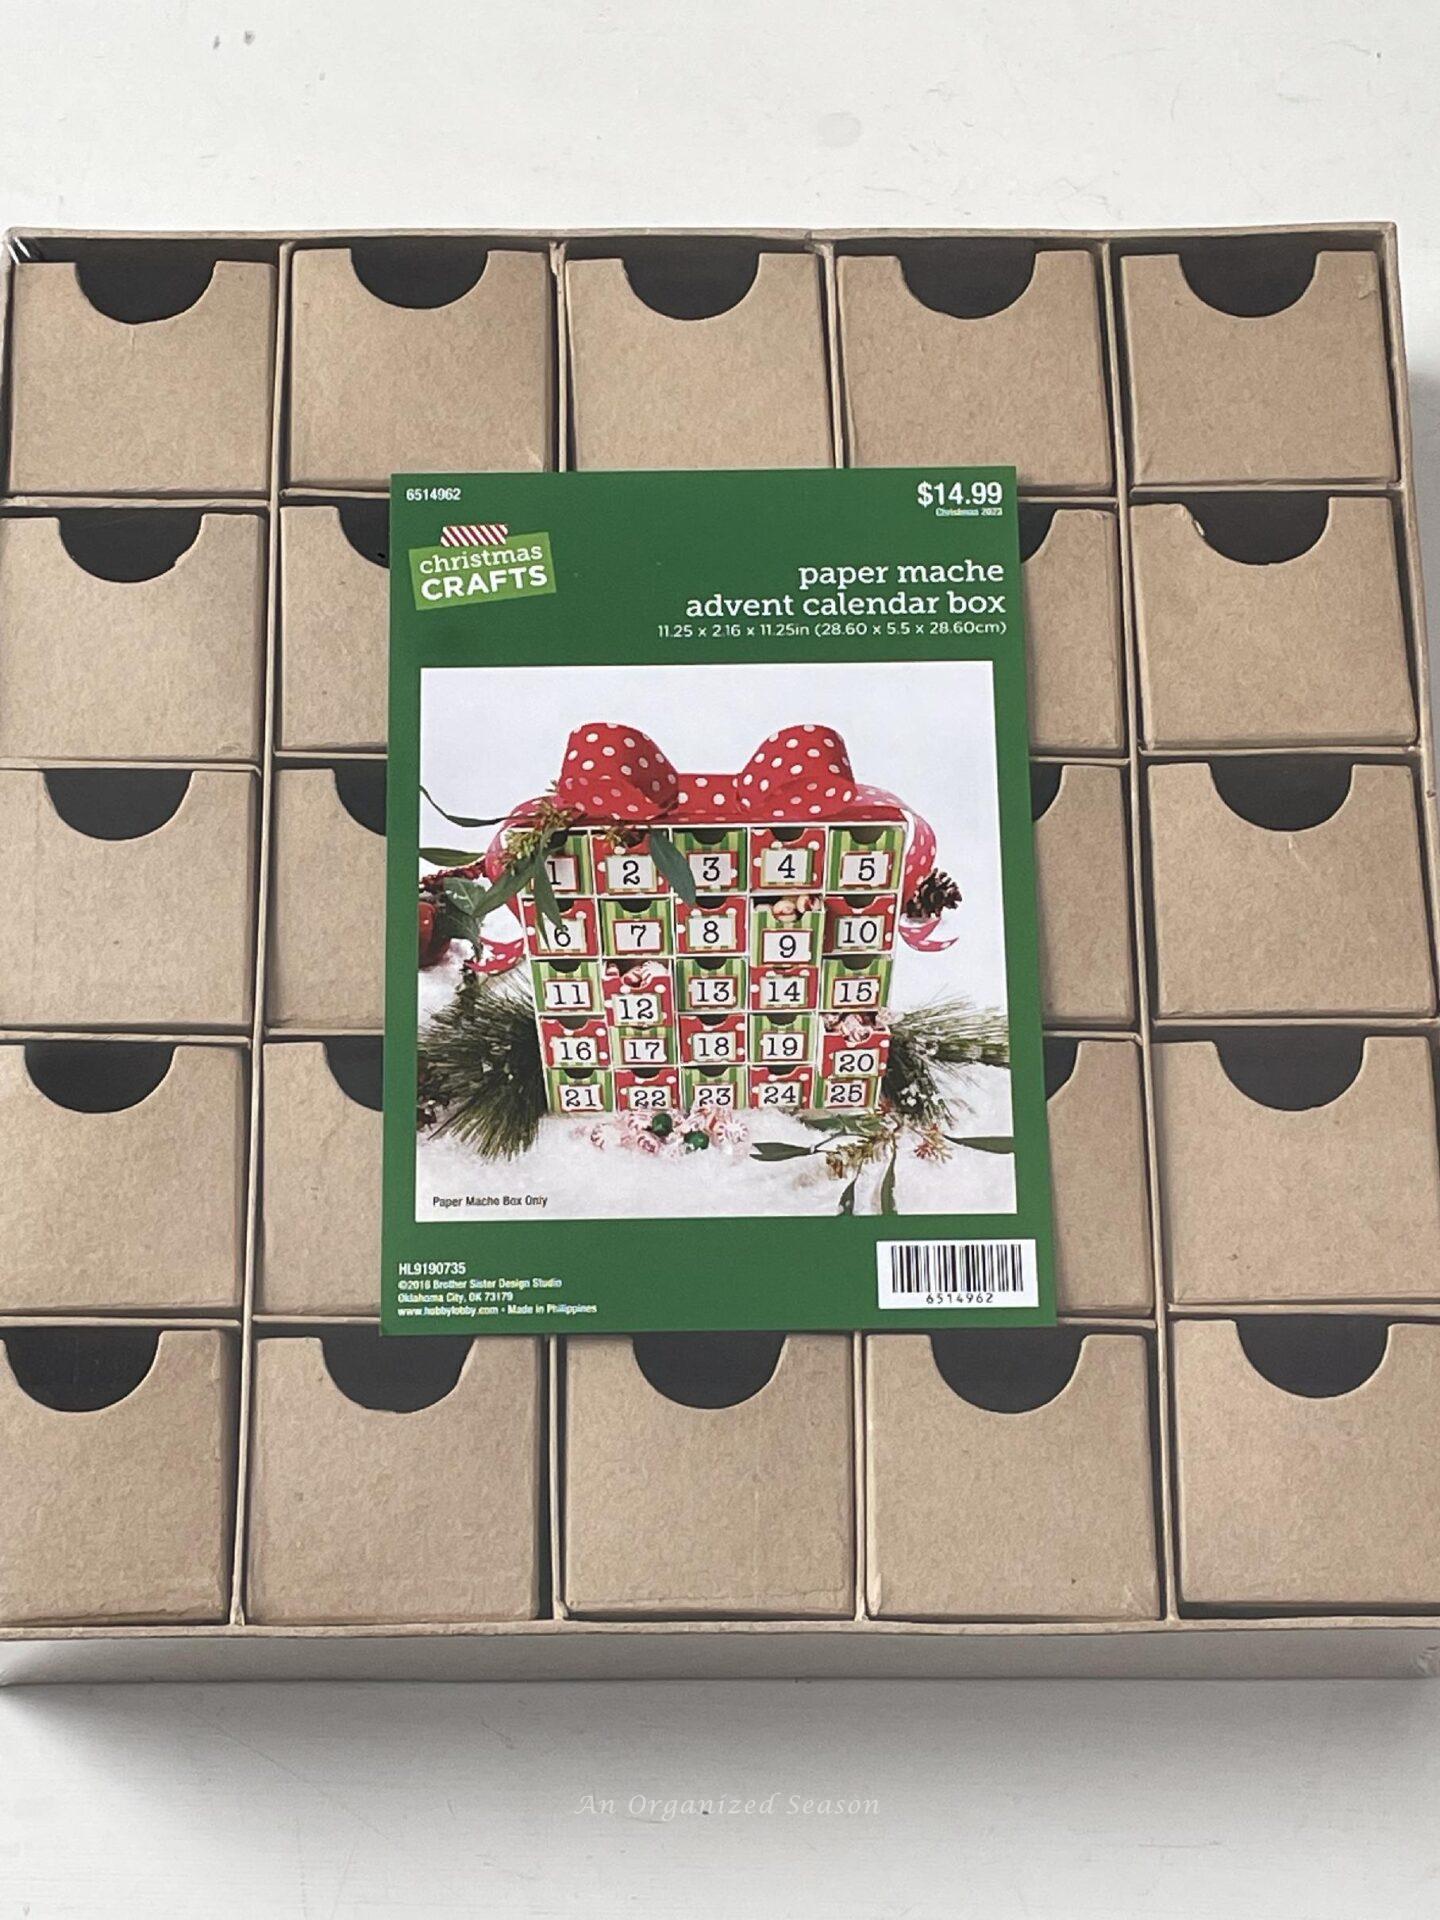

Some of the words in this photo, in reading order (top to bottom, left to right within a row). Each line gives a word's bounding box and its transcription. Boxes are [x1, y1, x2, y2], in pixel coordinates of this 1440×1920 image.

[405, 488, 462, 501] 6514962
[917, 481, 1003, 508] $14.99
[419, 545, 543, 574] christmas
[421, 564, 548, 601] CRAFTS
[798, 565, 888, 589] paper
[897, 560, 1005, 584] mache
[686, 594, 795, 617] advent
[802, 592, 939, 616] calendar
[946, 591, 1006, 614] box
[658, 624, 693, 638] 11.25
[698, 627, 707, 637] x
[712, 624, 741, 638] 2.16
[747, 626, 755, 636] x
[760, 623, 810, 636] 11.25in
[814, 622, 868, 637] (28.60
[872, 625, 882, 635] x
[886, 621, 911, 635] 5.5
[915, 624, 924, 634] x
[929, 620, 1007, 635] 28.60cm)
[547, 861, 562, 885] 1
[622, 860, 641, 885] 2
[702, 857, 721, 882] 3
[777, 854, 797, 879] 4
[857, 857, 876, 881] 5
[553, 925, 571, 947] 6
[630, 924, 648, 948] 7
[702, 920, 720, 944] 8
[778, 935, 797, 959] 9
[841, 919, 878, 943] 10
[552, 984, 584, 1005] 11
[619, 999, 654, 1020] 12
[696, 980, 731, 1003] 13
[767, 981, 801, 1003] 14
[838, 981, 873, 1004] 15
[559, 1041, 592, 1062] 16
[628, 1041, 660, 1061] 17
[698, 1037, 731, 1058] 18
[766, 1037, 799, 1058] 19
[838, 1052, 875, 1074] 20
[564, 1087, 598, 1108] 21
[633, 1089, 667, 1108] 22
[698, 1087, 732, 1107] 23
[763, 1085, 797, 1105] 24
[830, 1084, 864, 1103] 25
[433, 1196, 462, 1209] Paper
[465, 1196, 500, 1206] Mache
[502, 1195, 523, 1206] Box
[525, 1195, 548, 1207] Only
[398, 1262, 467, 1276] HL9190735
[433, 1279, 467, 1290] Brother
[469, 1278, 497, 1289] Sister
[498, 1278, 531, 1290] Design
[532, 1277, 563, 1288] Studio
[397, 1293, 444, 1303] Oklahoma
[468, 1292, 482, 1302] OK
[484, 1291, 514, 1302] 73179
[926, 1292, 994, 1304] 6514962
[397, 1306, 499, 1317] www.hobbylobby.com
[507, 1304, 534, 1314] Made
[535, 1304, 545, 1314] in
[546, 1303, 598, 1315] Philippines
